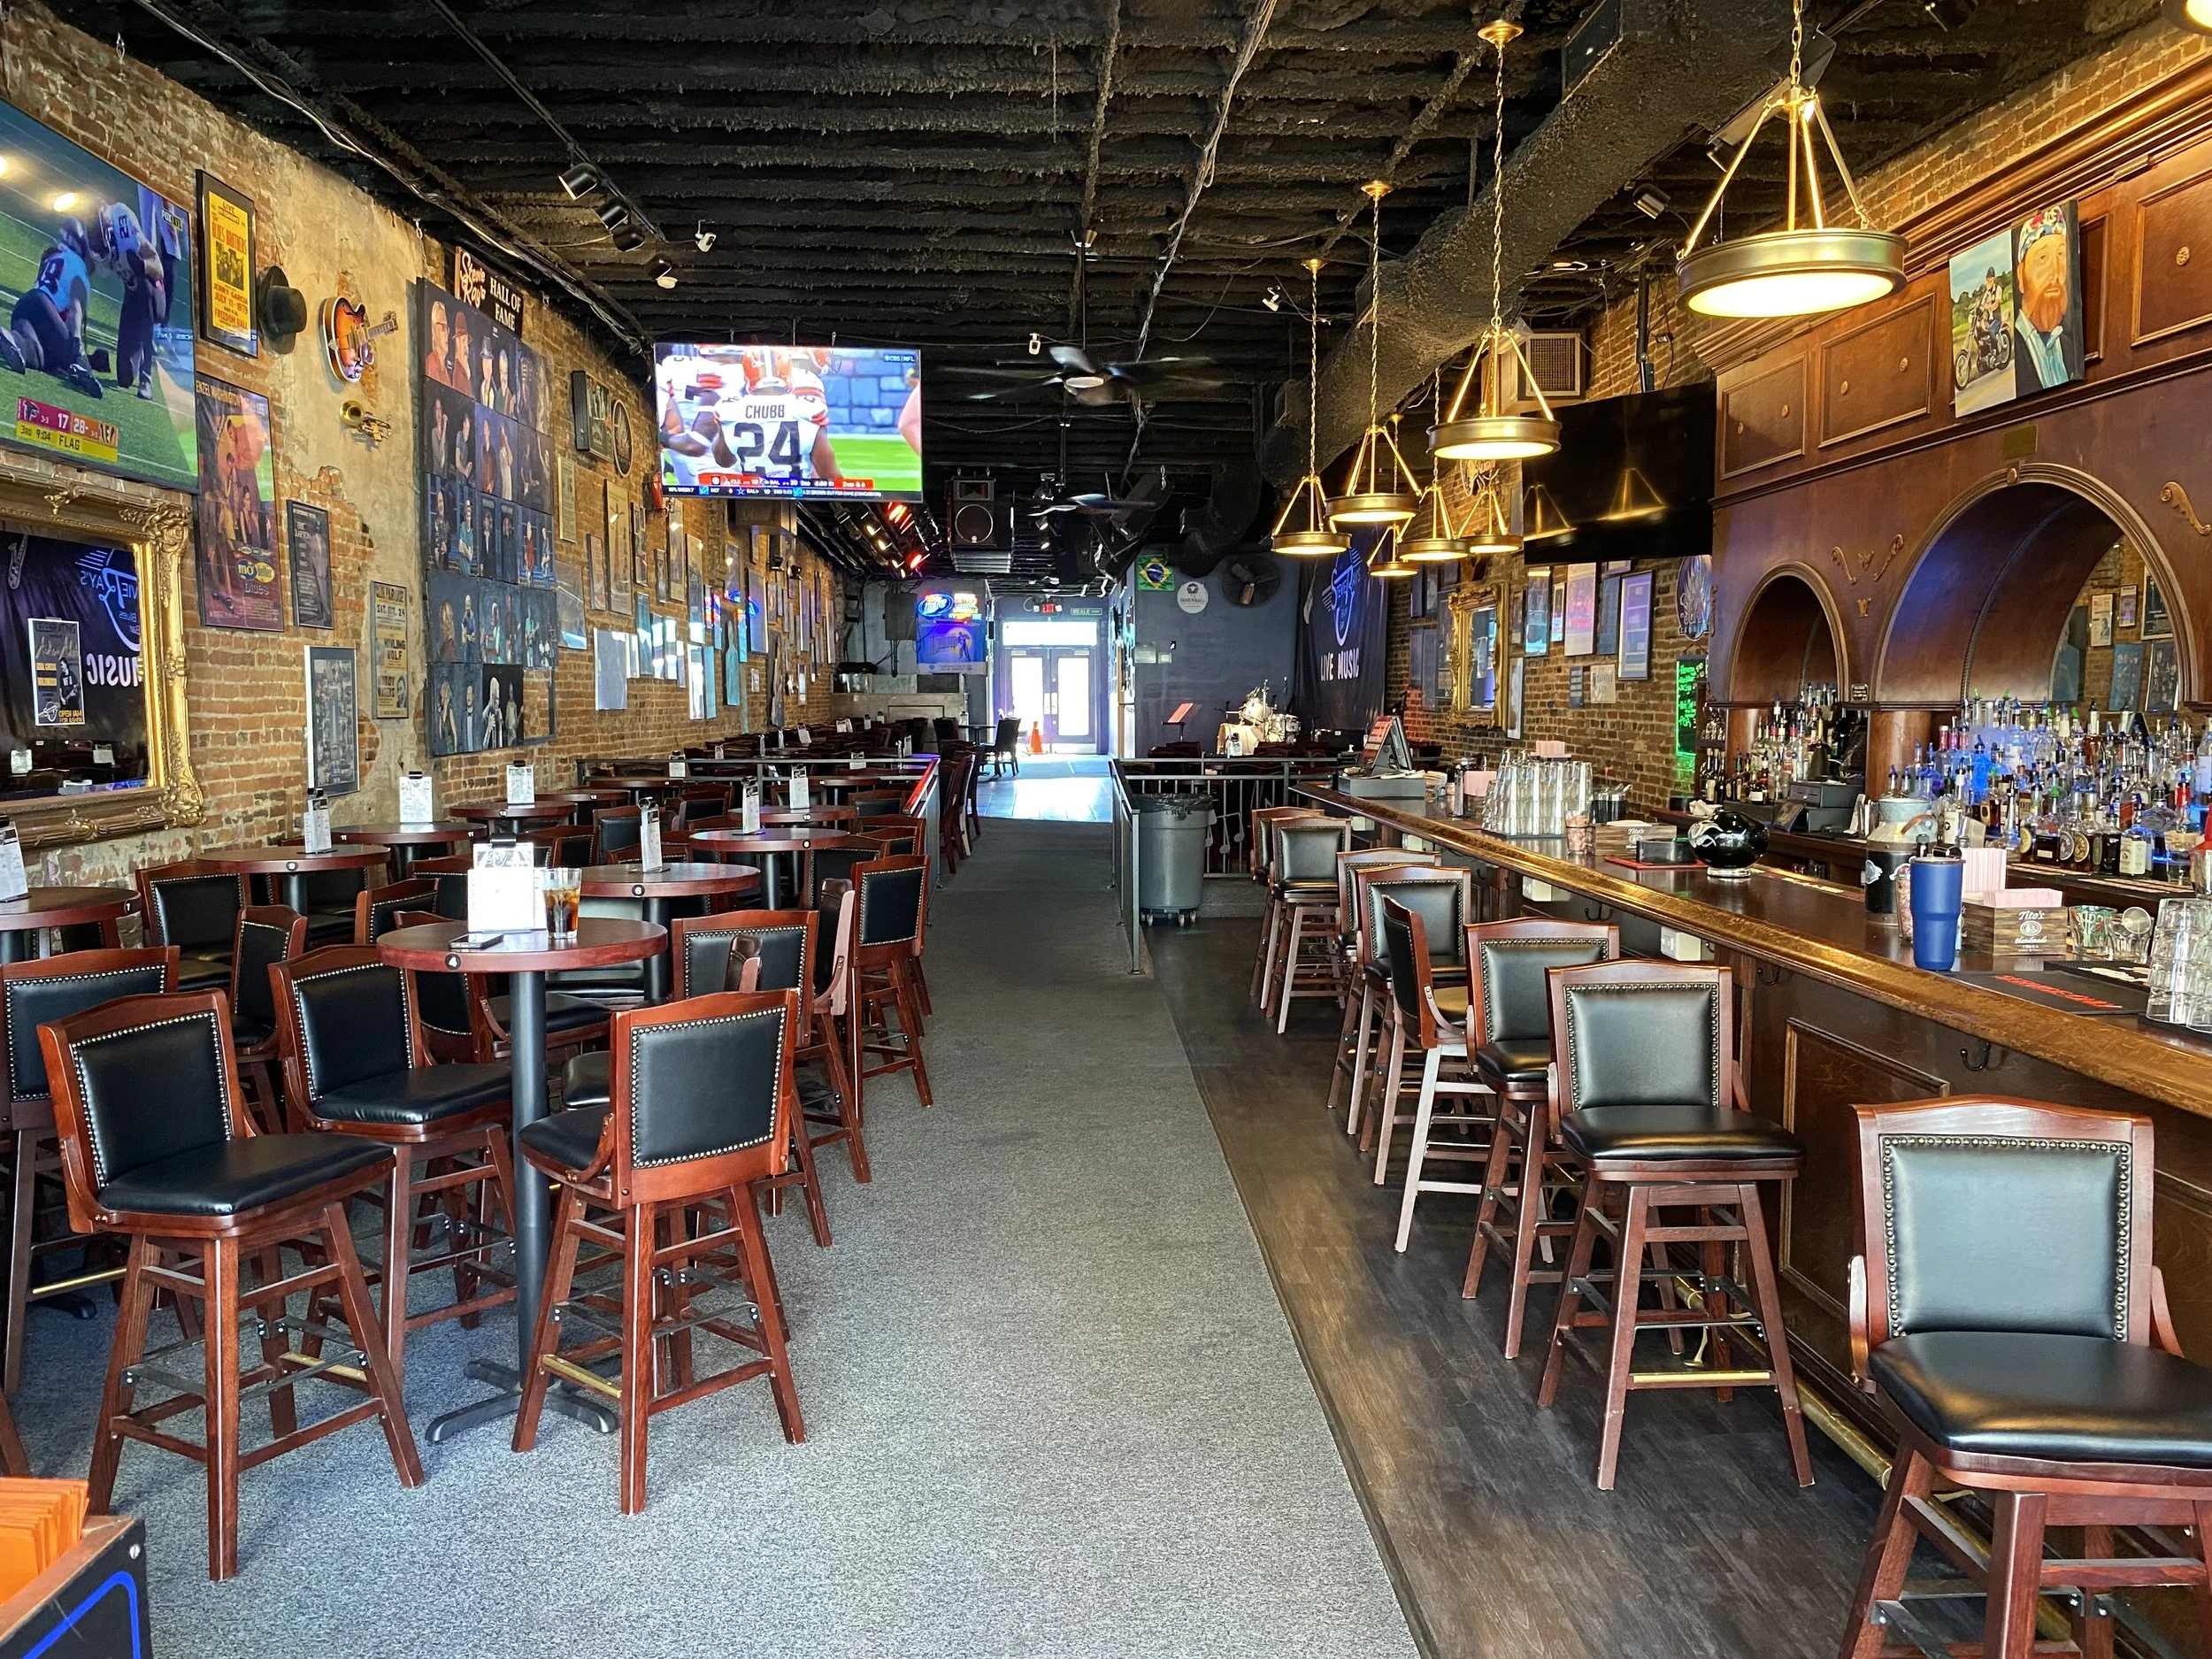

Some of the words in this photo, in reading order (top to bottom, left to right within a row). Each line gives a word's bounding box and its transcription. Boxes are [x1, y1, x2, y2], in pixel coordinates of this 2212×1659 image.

[223, 201, 235, 213] LIVE
[490, 276, 511, 306] HALL
[511, 293, 522, 313] OF
[495, 303, 516, 332] FAME
[745, 404, 786, 419] CHUBB
[58, 412, 70, 430] 17
[73, 418, 86, 435] 28
[58, 434, 81, 451] FLAG
[733, 420, 803, 478] 24
[1320, 651, 1334, 682] LIVE
[1337, 647, 1360, 680] MUSIC
[2018, 910, 2046, 920] Tito's
[2014, 935, 2047, 944] Handmade
[448, 956, 458, 968] 4
